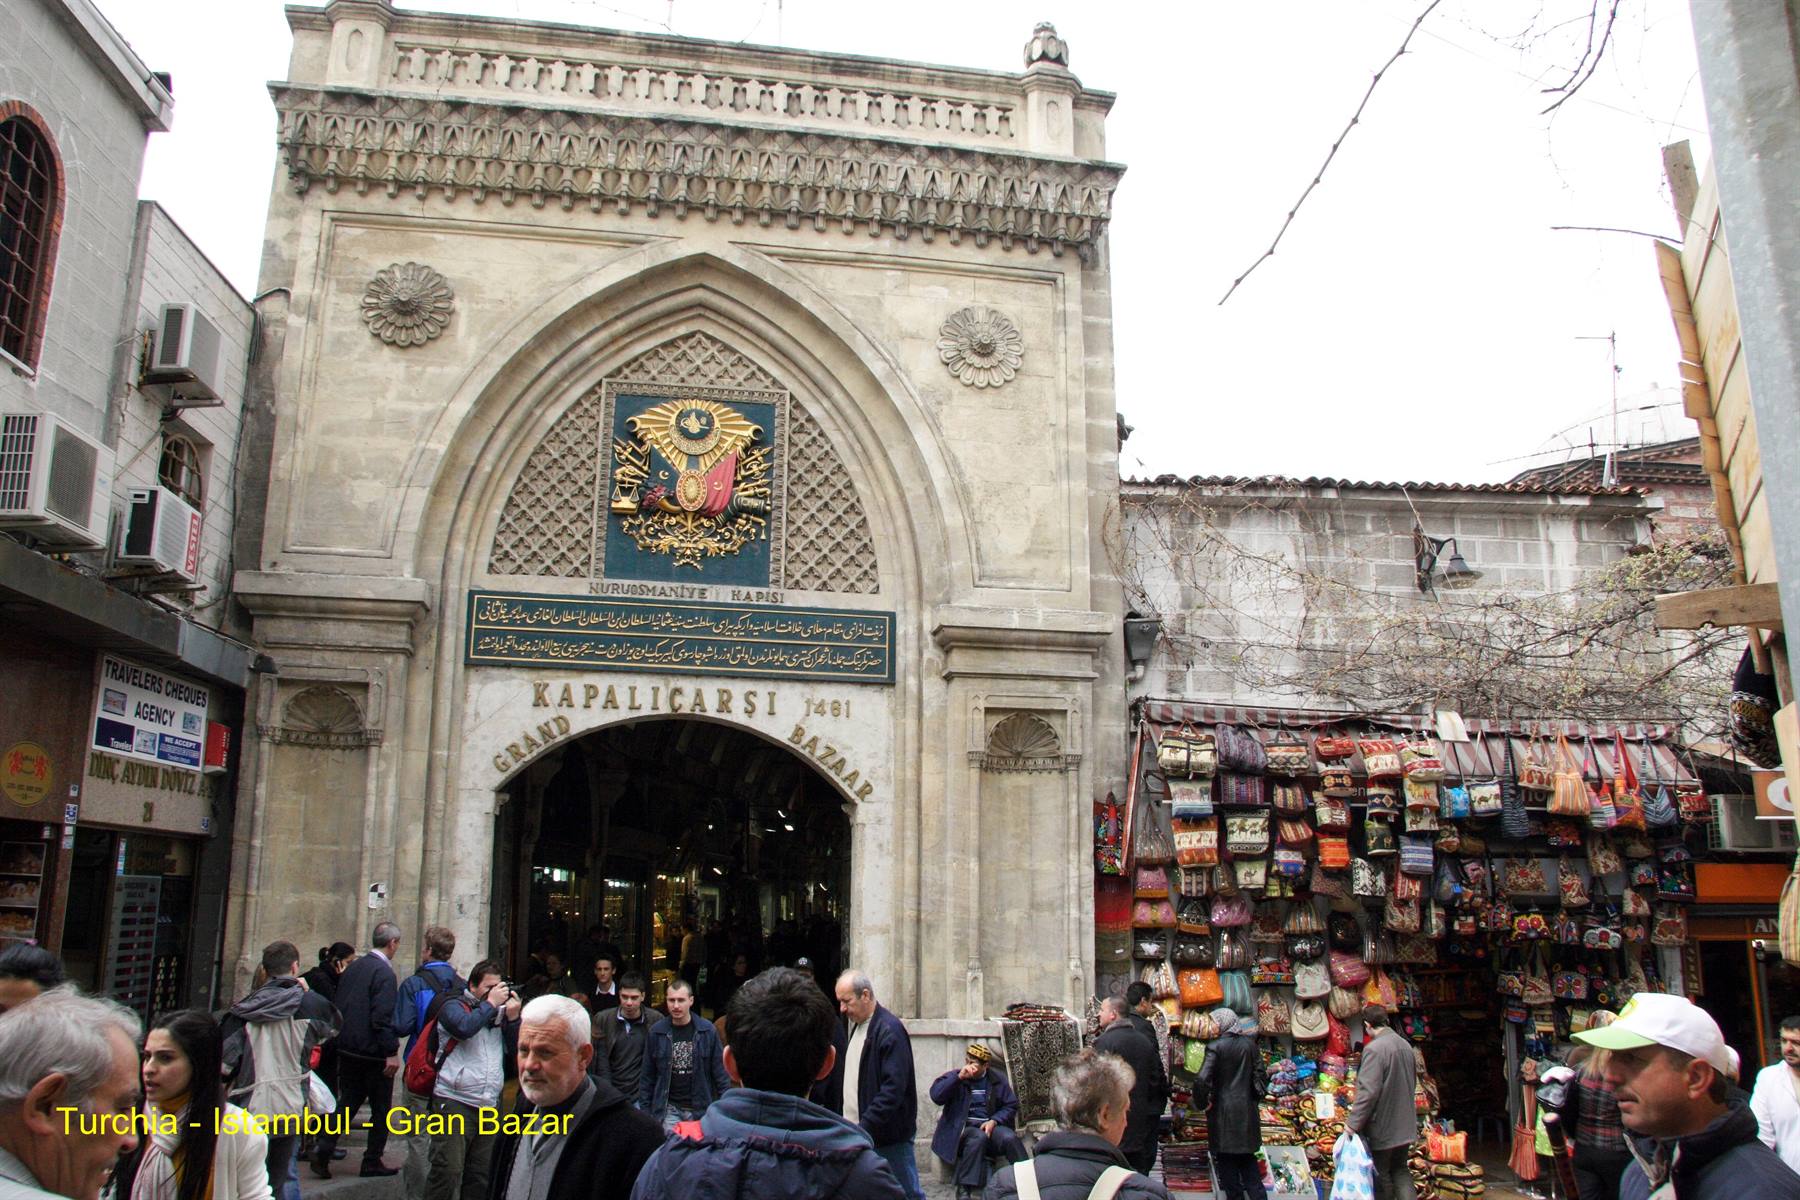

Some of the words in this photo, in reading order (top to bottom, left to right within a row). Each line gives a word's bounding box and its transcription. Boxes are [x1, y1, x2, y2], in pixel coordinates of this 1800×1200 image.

[187, 518, 199, 571] VESTEL
[731, 590, 785, 604] KAPISI
[104, 659, 163, 695] TRAVELERS
[165, 680, 207, 708] CHEQUES
[532, 682, 776, 719] KAPALIÇARŞI
[804, 698, 850, 720] 1461
[134, 701, 176, 728] AGENCY
[164, 736, 174, 745] WE
[174, 738, 197, 750] ACCEPT
[493, 715, 572, 773] GRAND
[787, 724, 874, 802] BAZAAR
